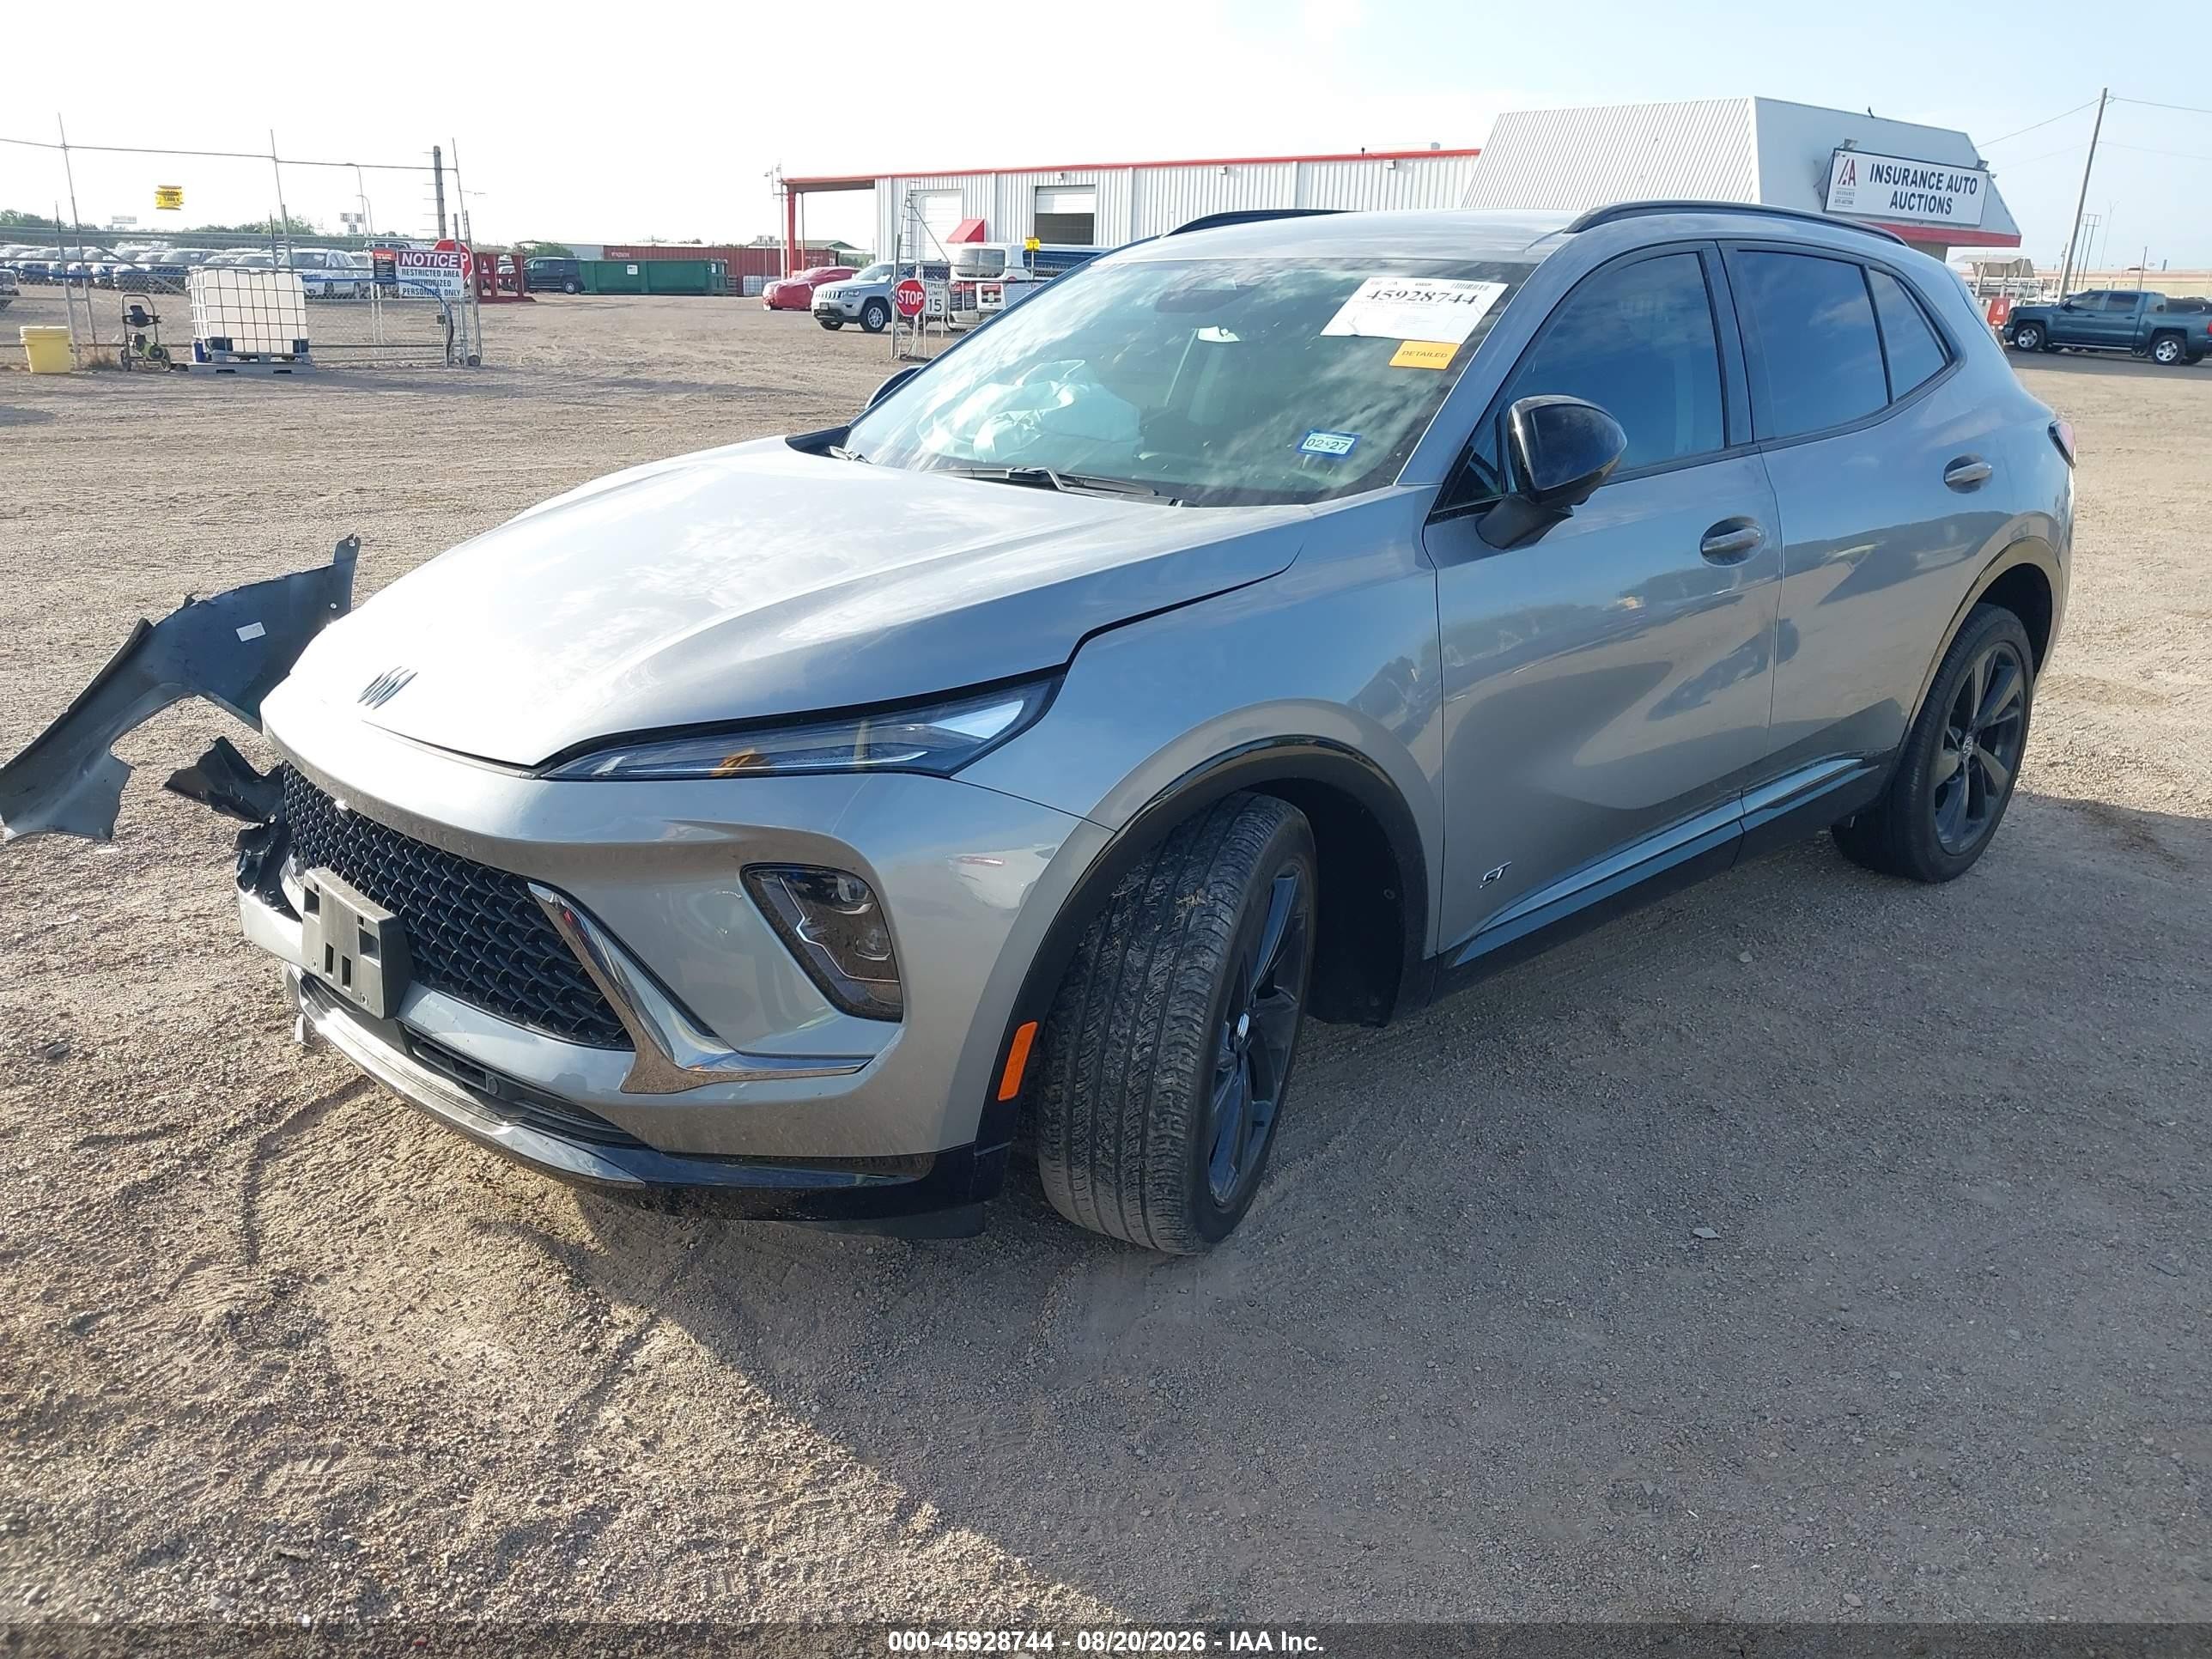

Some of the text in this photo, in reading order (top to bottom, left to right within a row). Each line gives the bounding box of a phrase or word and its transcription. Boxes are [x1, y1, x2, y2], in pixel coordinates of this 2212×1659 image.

[1869, 163, 1978, 195] INSURANCE AUTO
[1889, 190, 1954, 216] AUCTIONS
[401, 252, 459, 268] NOTICE
[897, 289, 924, 306] STOP
[928, 298, 942, 312] 15
[1366, 289, 1478, 305] 45928744
[1306, 438, 1349, 451] 02 27
